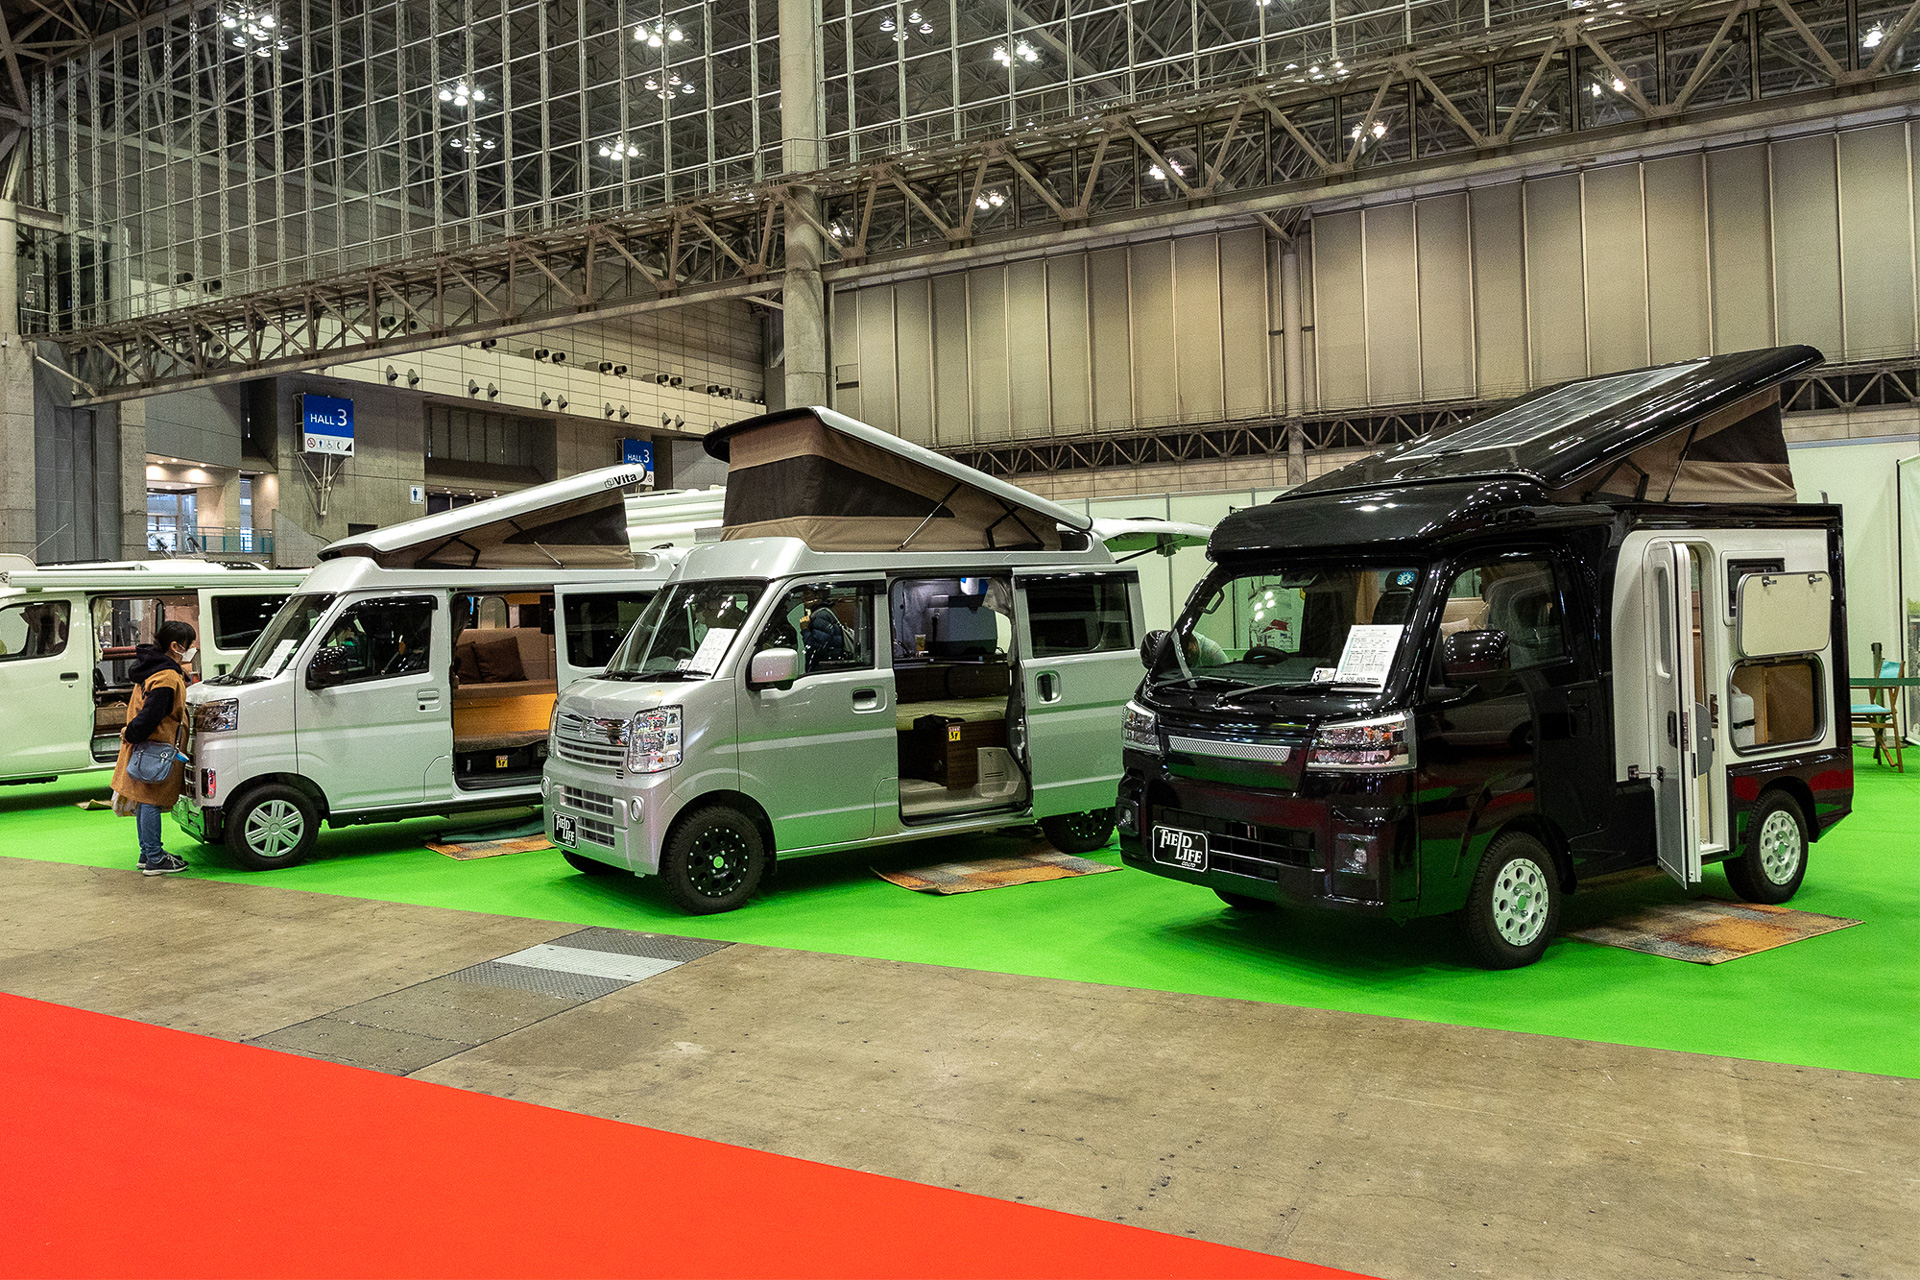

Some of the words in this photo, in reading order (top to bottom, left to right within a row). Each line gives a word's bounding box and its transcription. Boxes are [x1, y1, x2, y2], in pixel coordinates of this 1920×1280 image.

[310, 413, 335, 426] HALL
[337, 408, 348, 427] 3
[627, 453, 642, 463] HALL
[643, 449, 650, 463] 3
[613, 473, 637, 485] Vita
[556, 815, 571, 831] FIELD
[562, 829, 575, 842] LIFE
[1159, 828, 1193, 849] FIELD
[1174, 847, 1203, 864] LIFE
